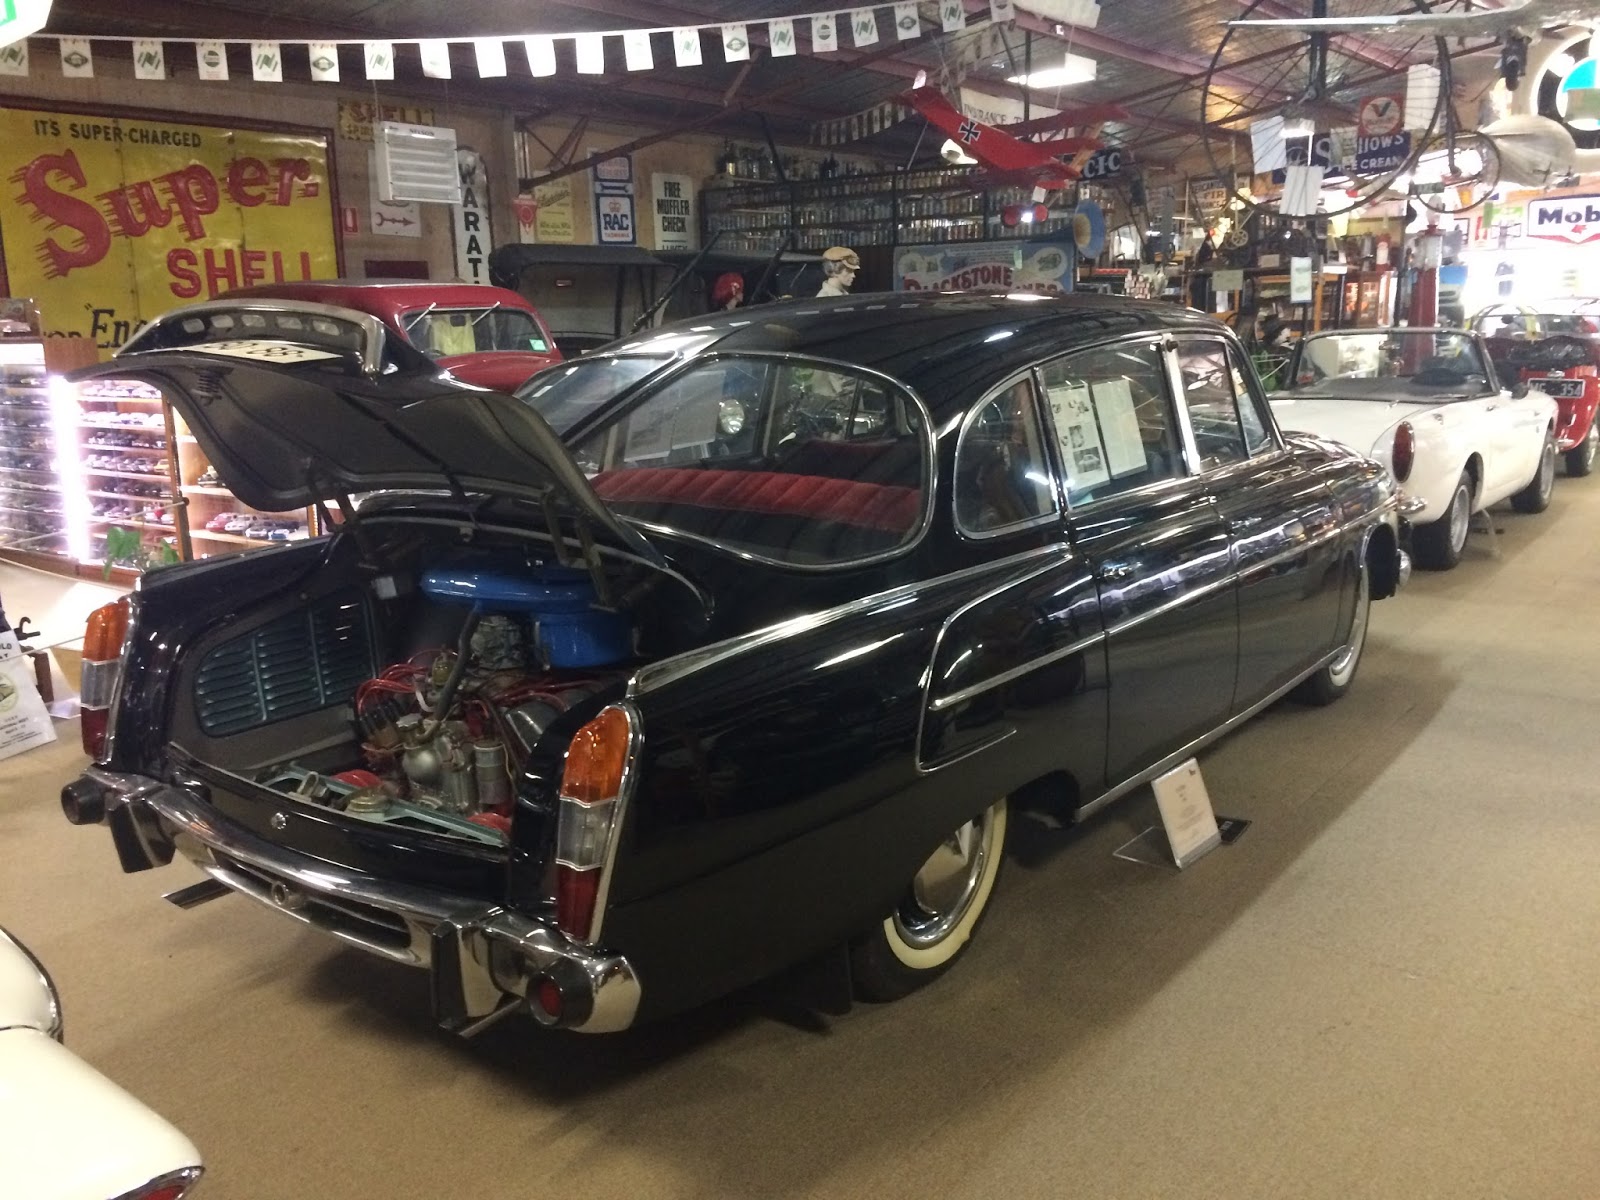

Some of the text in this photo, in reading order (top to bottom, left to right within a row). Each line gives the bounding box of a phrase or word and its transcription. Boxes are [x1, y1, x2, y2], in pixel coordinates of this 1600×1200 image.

[664, 181, 681, 198] FREE
[657, 198, 690, 215] MUFFLER
[603, 213, 630, 231] RAC
[662, 216, 687, 232] CHECK
[1560, 383, 1581, 396] 354
